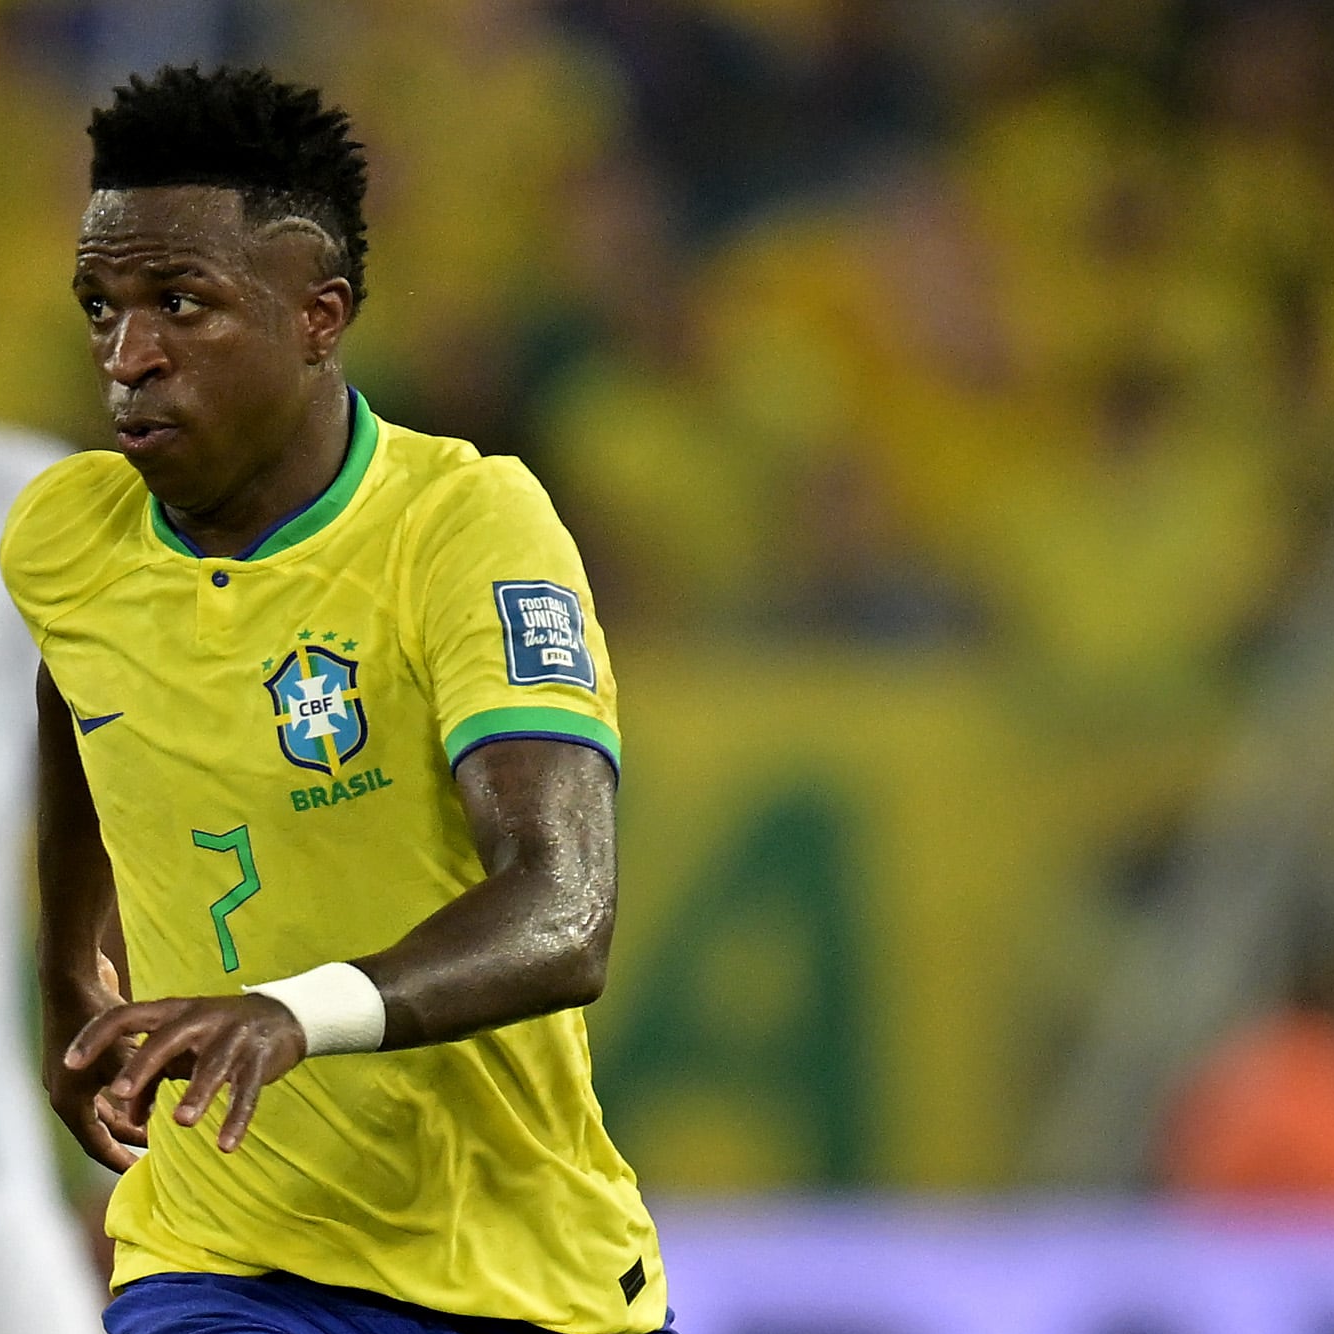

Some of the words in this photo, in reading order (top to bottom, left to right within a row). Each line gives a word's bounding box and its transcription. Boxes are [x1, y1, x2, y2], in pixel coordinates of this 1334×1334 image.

[519, 597, 570, 616] FOOTBALL
[522, 610, 572, 638] UNITES
[523, 629, 547, 647] the
[298, 696, 334, 718] CBF
[290, 768, 394, 812] BRASIL
[191, 823, 261, 974] 7
